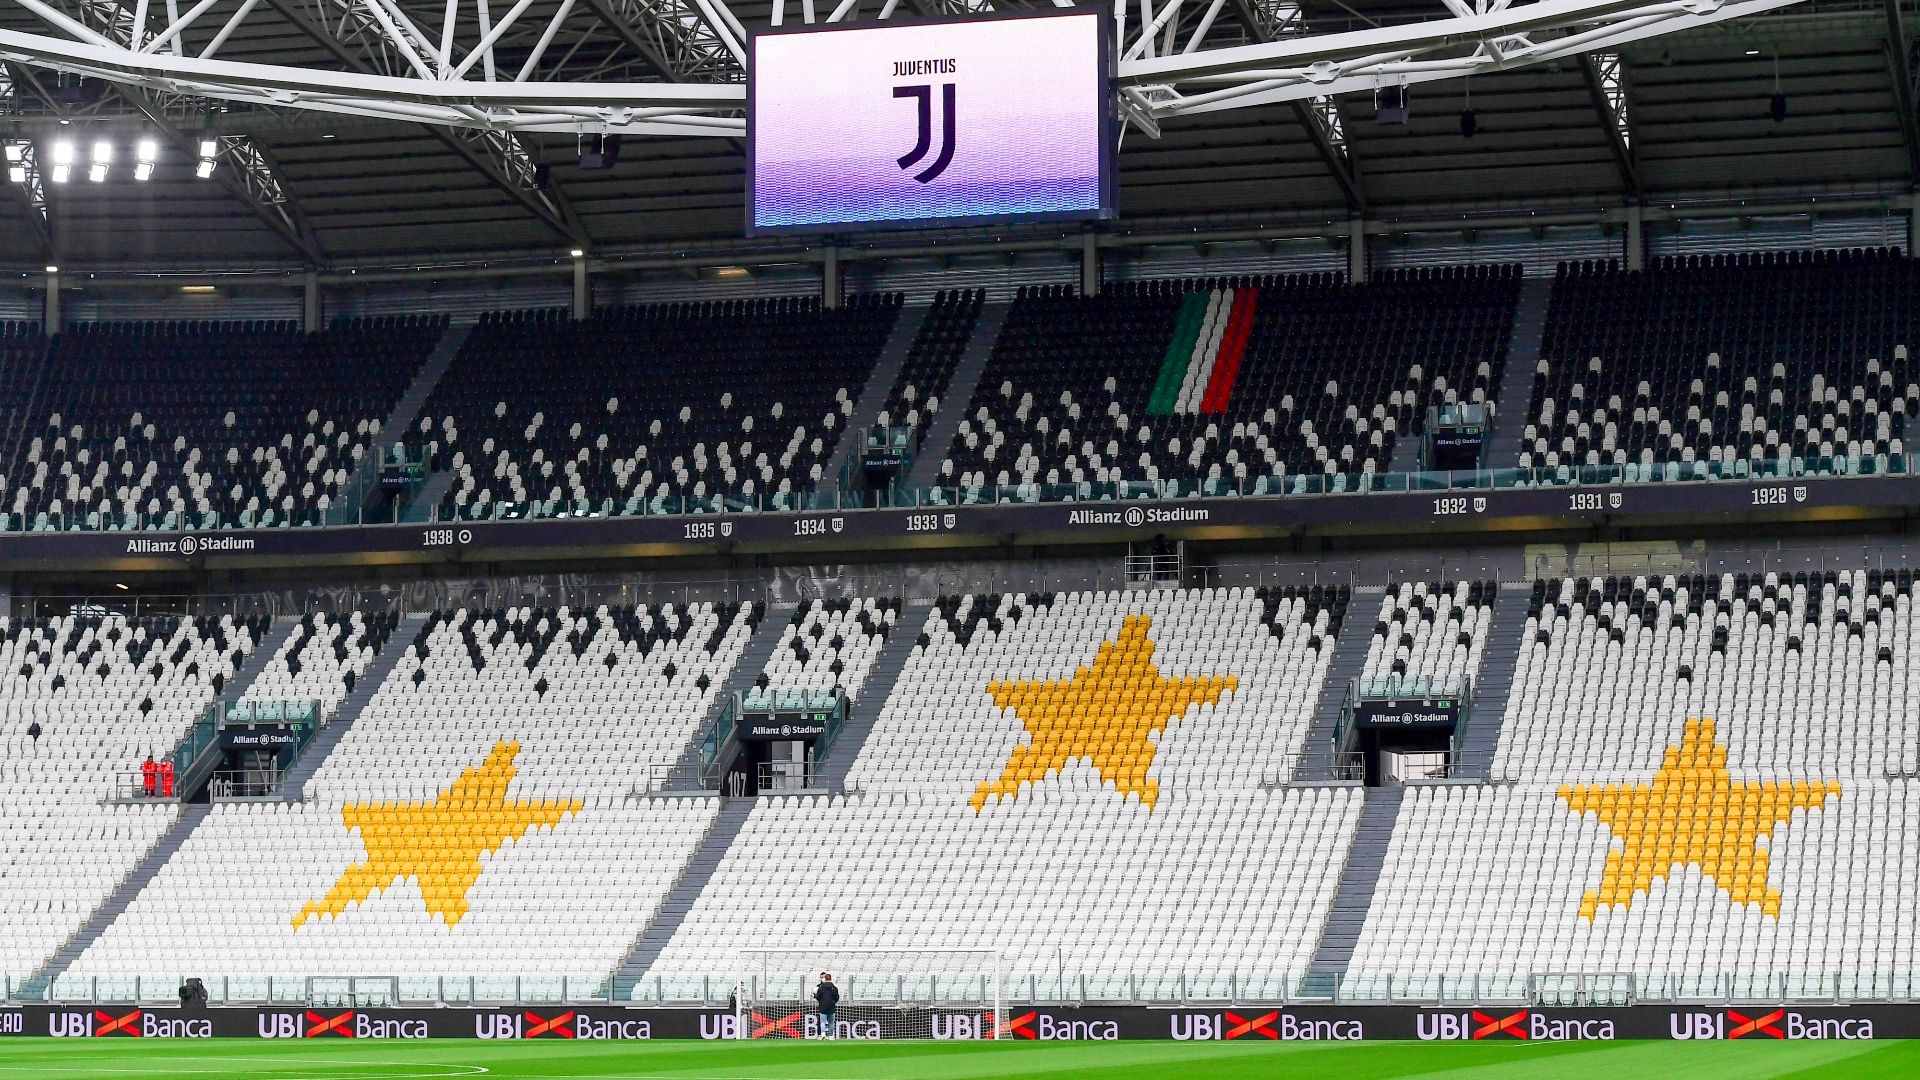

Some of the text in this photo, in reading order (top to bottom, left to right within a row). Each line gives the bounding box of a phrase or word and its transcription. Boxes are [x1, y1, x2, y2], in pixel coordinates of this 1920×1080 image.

[893, 59, 956, 76] JUVENTUS
[1570, 493, 1603, 510] 1931
[1752, 487, 1786, 504] 1926
[1433, 497, 1467, 514] 1932
[906, 514, 938, 530] 1933
[1069, 507, 1209, 524] Allianz Stadium
[684, 522, 715, 538] 1935
[794, 518, 826, 535] 1934
[127, 536, 255, 553] Allianz Stadium
[423, 529, 453, 545] 1938
[1371, 713, 1449, 723] Allianz Stadium
[752, 725, 824, 735] Allianz Stadium
[233, 736, 259, 744] Allianz
[729, 771, 747, 798] 107
[49, 1012, 212, 1038] UBI Banca
[258, 1013, 428, 1039] UBI Banca
[475, 1014, 650, 1039] UBI Banca
[700, 1014, 880, 1040] UBI Bnca
[931, 1014, 1119, 1040] UBI Banca
[1170, 1014, 1363, 1040] UBI Banca
[1416, 1013, 1615, 1040] UBI Banca
[1670, 1012, 1873, 1040] UBI Banca
